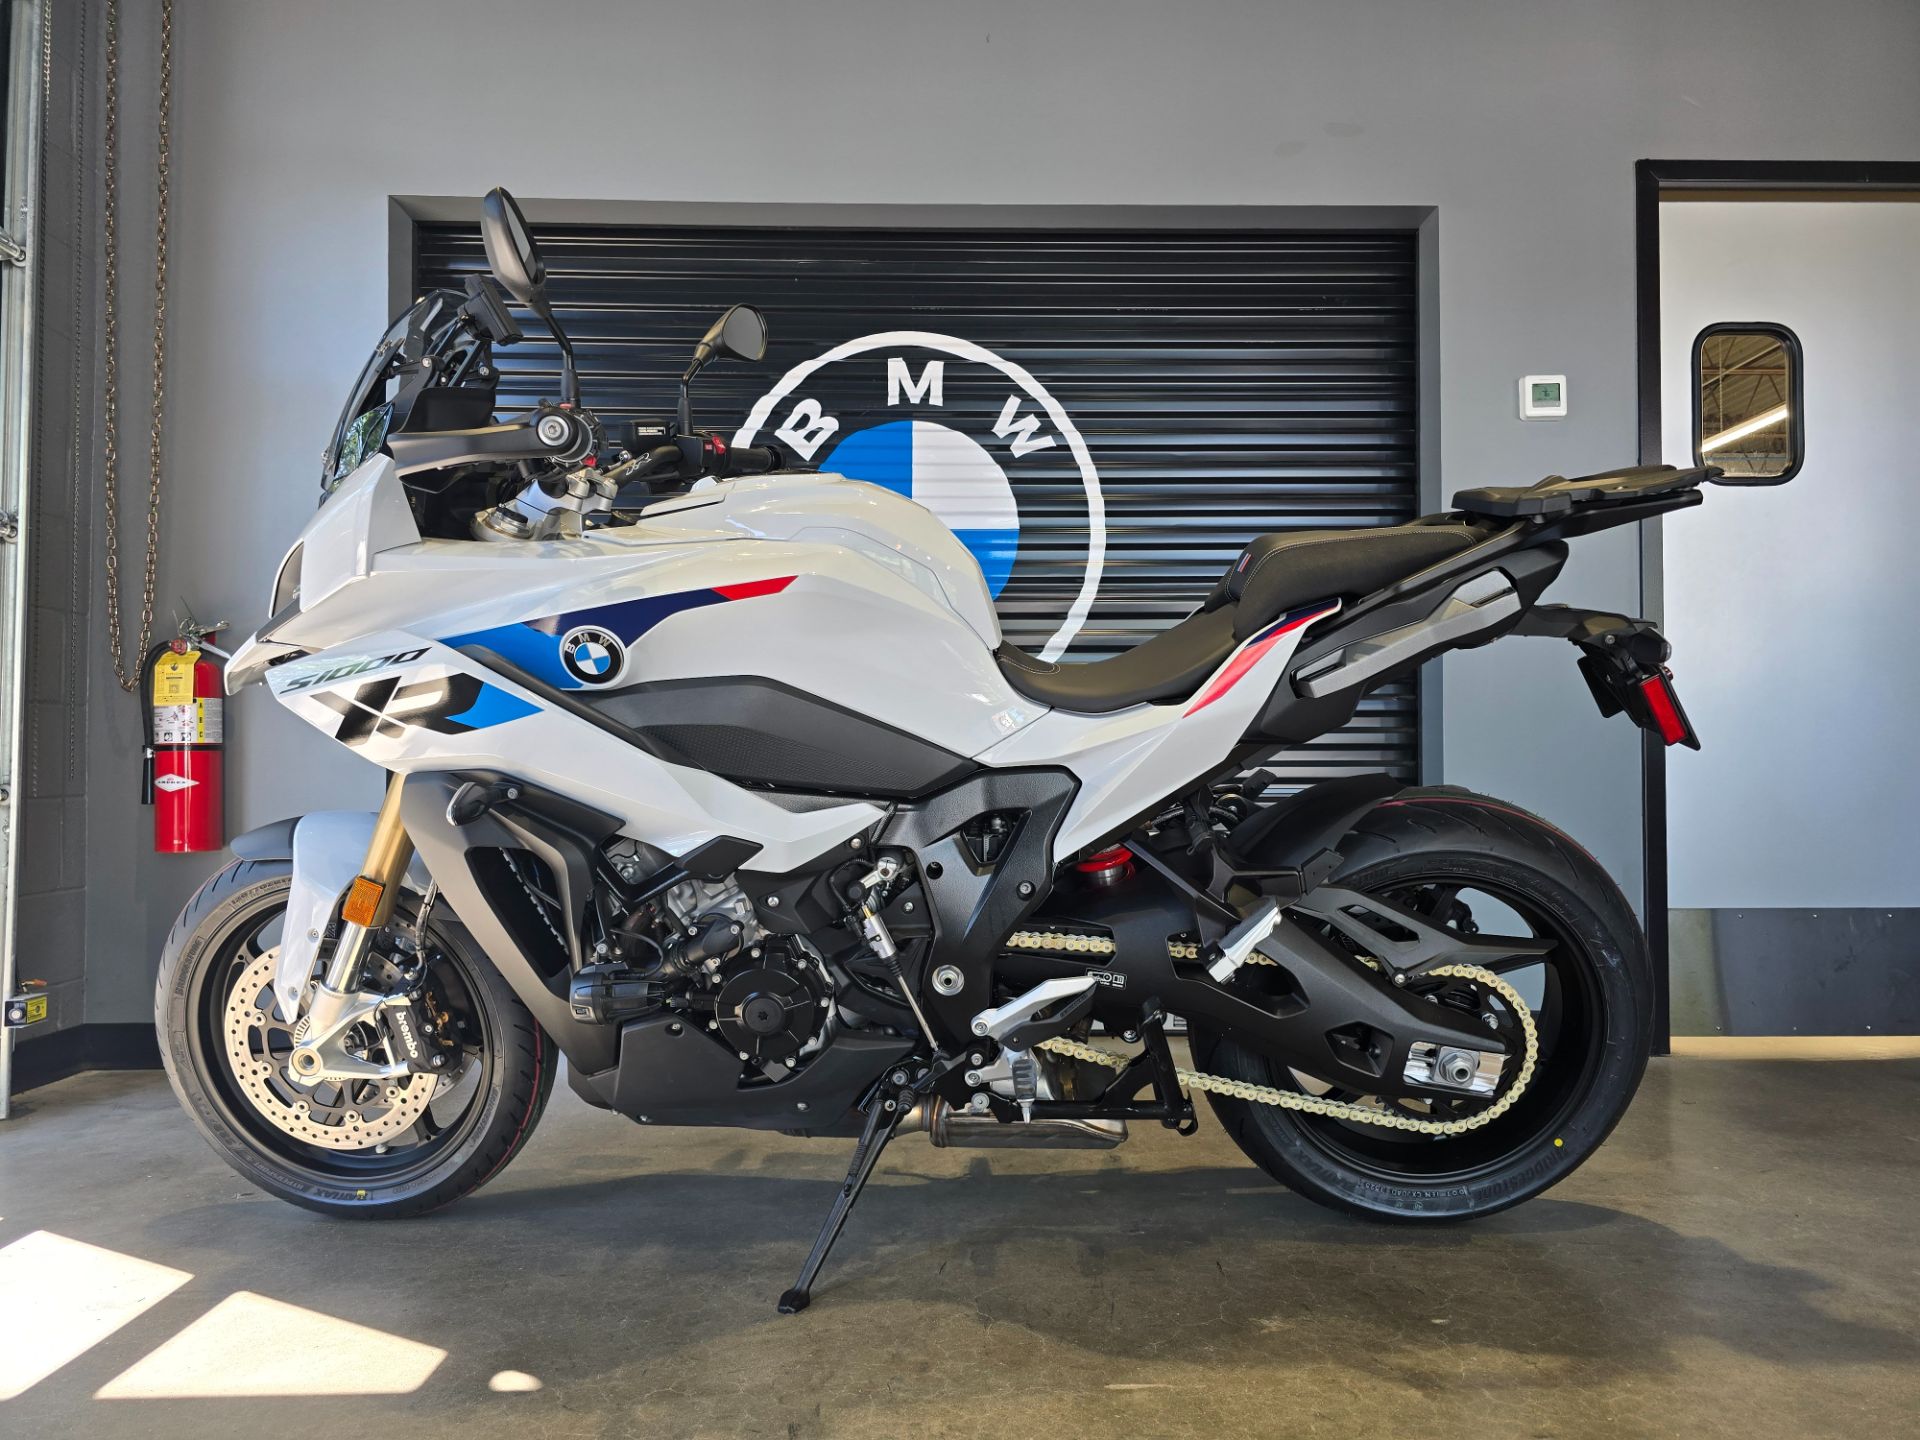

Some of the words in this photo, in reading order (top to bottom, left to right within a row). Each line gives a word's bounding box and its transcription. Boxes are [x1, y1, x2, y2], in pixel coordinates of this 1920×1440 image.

[775, 357, 1057, 462] BMW
[564, 633, 612, 654] BMW
[279, 646, 433, 695] S1000
[309, 672, 492, 747] XR
[395, 1011, 419, 1059] brembo
